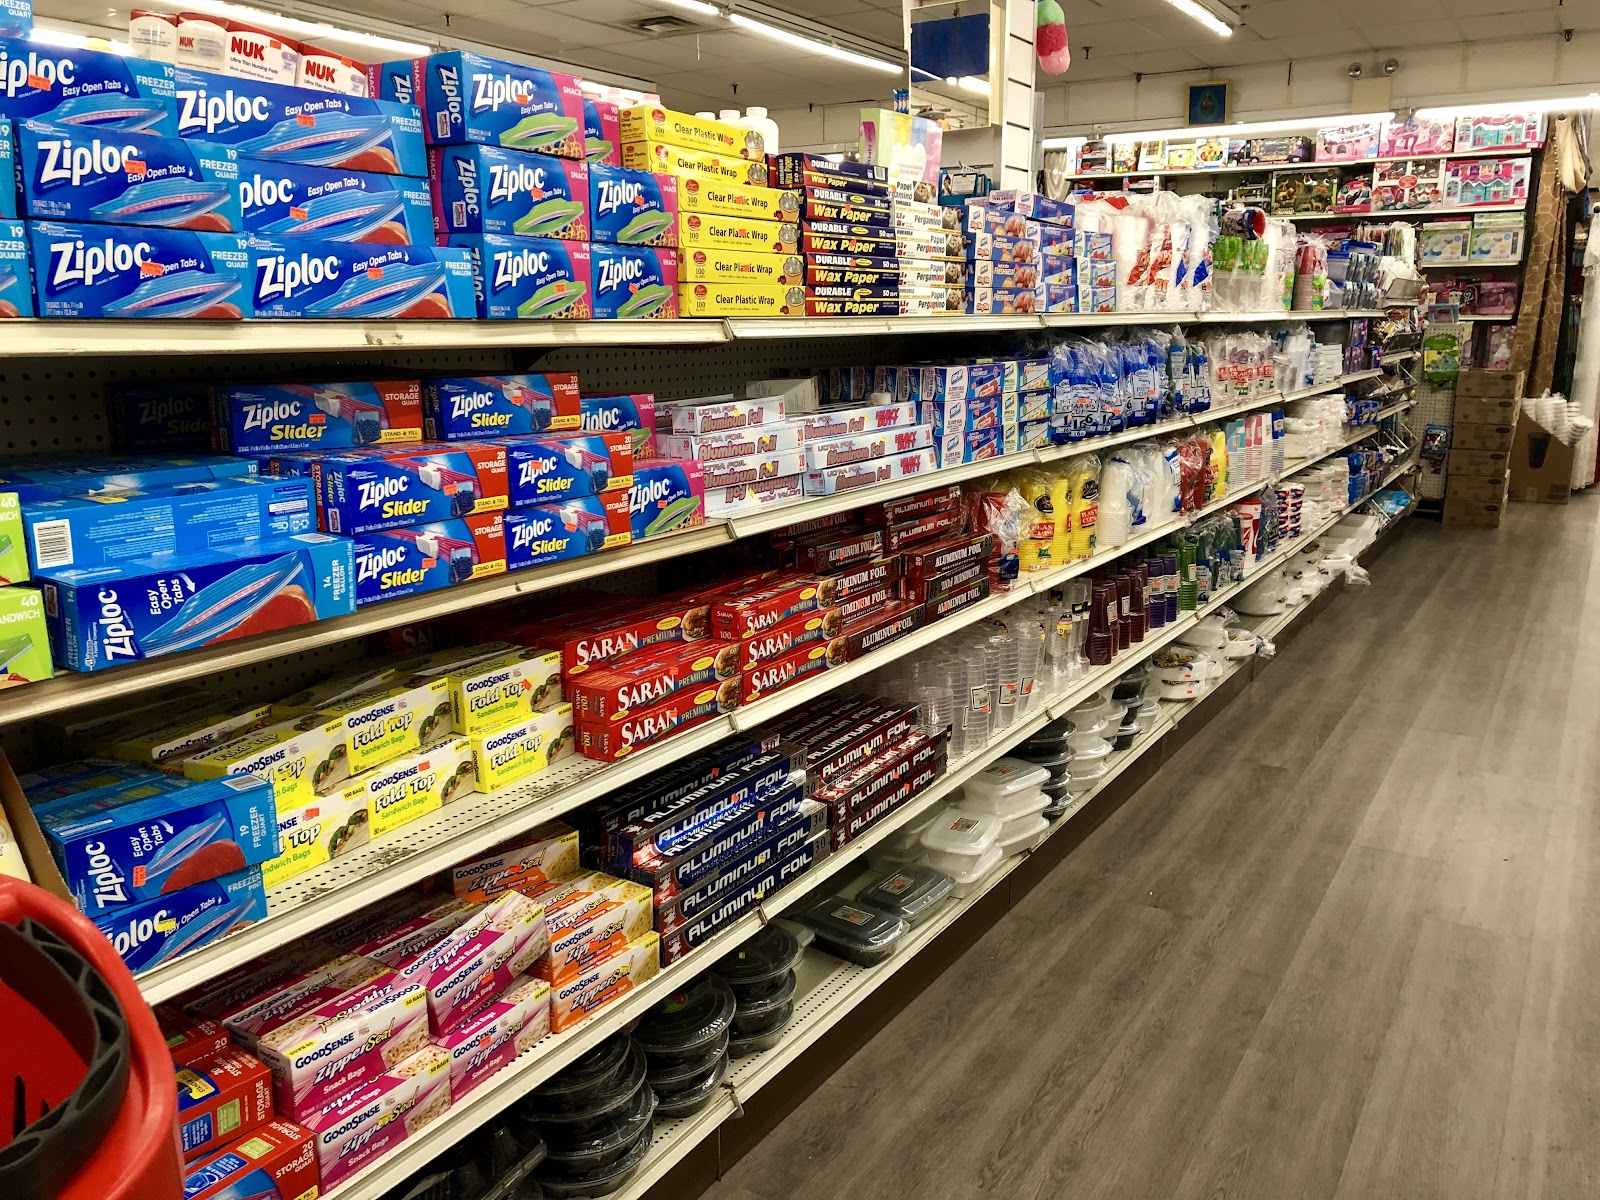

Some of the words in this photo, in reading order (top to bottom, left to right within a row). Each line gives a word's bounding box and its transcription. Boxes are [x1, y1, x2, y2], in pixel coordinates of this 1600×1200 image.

[179, 36, 194, 48] NUK
[230, 36, 265, 60] NUK
[164, 66, 174, 78] 19
[305, 60, 336, 83] NUK
[152, 87, 175, 98] QUART
[472, 74, 533, 111] Ziploc
[563, 87, 582, 96] SNACK
[573, 79, 581, 87] 90
[440, 66, 462, 124] Ziploc
[176, 90, 269, 134] Ziploc
[392, 116, 421, 127] FREEZER
[412, 108, 420, 117] 14
[400, 125, 421, 133] GALLON
[38, 140, 138, 186] Ziploc
[227, 150, 236, 159] 19
[215, 170, 238, 180] QUART
[678, 159, 694, 169] Clear
[697, 162, 718, 174] Plastic
[720, 166, 737, 178] Wrap
[812, 161, 839, 170] DURABLE
[490, 164, 544, 201] Ziploc
[571, 171, 588, 180] SNACK
[812, 176, 827, 184] Wax
[828, 179, 847, 187] Paper
[308, 186, 323, 197] Easy
[325, 182, 342, 192] Open
[344, 178, 358, 188] Tabs
[404, 191, 430, 200] FREEZER
[897, 182, 912, 190] Papel
[814, 204, 837, 216] Wax
[840, 208, 871, 222] Paper
[915, 215, 941, 225] Pergamino
[10, 226, 23, 237] 19
[812, 222, 848, 233] DURABLE
[237, 240, 247, 248] 19
[811, 238, 840, 249] Wax
[842, 241, 875, 255] Paper
[930, 236, 944, 244] Papel
[51, 239, 152, 286] Ziploc
[212, 252, 248, 262] FREEZER
[463, 252, 470, 260] 14
[574, 252, 589, 260] SNACK
[257, 253, 339, 298] Ziploc
[446, 262, 472, 270] FREEZER
[494, 249, 548, 286] Ziploc
[599, 256, 642, 292] Ziploc
[816, 271, 840, 281] Wax
[844, 273, 879, 284] Paper
[716, 295, 733, 303] Clear
[736, 296, 756, 304] Plastic
[758, 296, 774, 305] Wrap
[815, 287, 851, 296] DURABLE
[815, 302, 840, 313] Wax
[844, 303, 879, 315] Paper
[451, 392, 493, 419] Ziploc
[243, 401, 300, 431] Ziploc
[471, 413, 512, 428] Slider
[701, 412, 746, 432] Aluminum
[748, 408, 763, 425] Foil
[849, 417, 864, 432] Foil
[270, 424, 327, 440] Slider
[497, 451, 505, 459] 20
[610, 444, 631, 452] STORAGE
[698, 441, 755, 461] Aluminum
[758, 435, 777, 453] Foil
[827, 446, 869, 466] Aluminum
[871, 441, 885, 457] Foil
[247, 465, 256, 473] 10
[477, 460, 506, 469] STORAGE
[704, 468, 757, 489] Aluminum
[759, 461, 779, 479] Foil
[835, 471, 876, 491] Aluminum
[877, 465, 891, 481] Foil
[358, 476, 407, 510] Ziploc
[934, 495, 948, 504] FOIL
[382, 499, 430, 518] Slider
[606, 502, 628, 510] STORAGE
[474, 526, 502, 535] STORAGE
[512, 518, 552, 549] Ziploc
[531, 538, 570, 556] Slider
[356, 546, 406, 582] Ziploc
[324, 576, 331, 587] 14
[332, 560, 340, 600] FREEZER
[21, 595, 38, 606] 40
[151, 590, 161, 615] Easy
[967, 587, 980, 599] FOIL
[98, 590, 136, 660] Ziploc
[471, 688, 499, 712] Fold
[504, 681, 525, 698] Top
[618, 674, 674, 711] SARAN
[678, 671, 708, 687] PREMIUM
[477, 705, 500, 720] Sandwich
[502, 700, 518, 712] Bags
[353, 721, 385, 750] Fold
[491, 747, 516, 770] Fold
[522, 735, 542, 754] Top
[823, 734, 882, 778] ALUMINUM
[887, 720, 910, 739] FOIL
[793, 756, 803, 769] 30
[851, 761, 909, 807] ALUMINUM
[913, 746, 935, 764] FOIL
[282, 783, 297, 793] Bags
[353, 787, 364, 795] BAGS
[375, 782, 408, 812] Fold
[410, 773, 436, 794] Top
[381, 802, 412, 820] Sandwich
[413, 795, 428, 807] Bags
[851, 786, 909, 833] ALUMINUM
[913, 770, 935, 789] FOIL
[250, 806, 260, 847] FREEZER
[813, 813, 823, 827] 30
[152, 825, 164, 846] Tabs
[241, 825, 249, 836] 19
[289, 823, 320, 848] Top
[679, 819, 764, 879] ALUMINUM
[770, 799, 800, 821] FOIL
[133, 836, 143, 857] Easy
[87, 841, 126, 909] Ziploc
[684, 849, 770, 912] ALUMINUM
[778, 829, 809, 852] FOIL
[689, 875, 774, 942] ALUMINUM
[781, 854, 812, 879] FOIL
[554, 926, 594, 952] GOODSENSE
[435, 958, 483, 998] GOODSENSE
[295, 1033, 354, 1068] GOODSENSE
[313, 1017, 395, 1084] ZipperSeal
[323, 1077, 346, 1094] Snack
[348, 1067, 366, 1082] Bags
